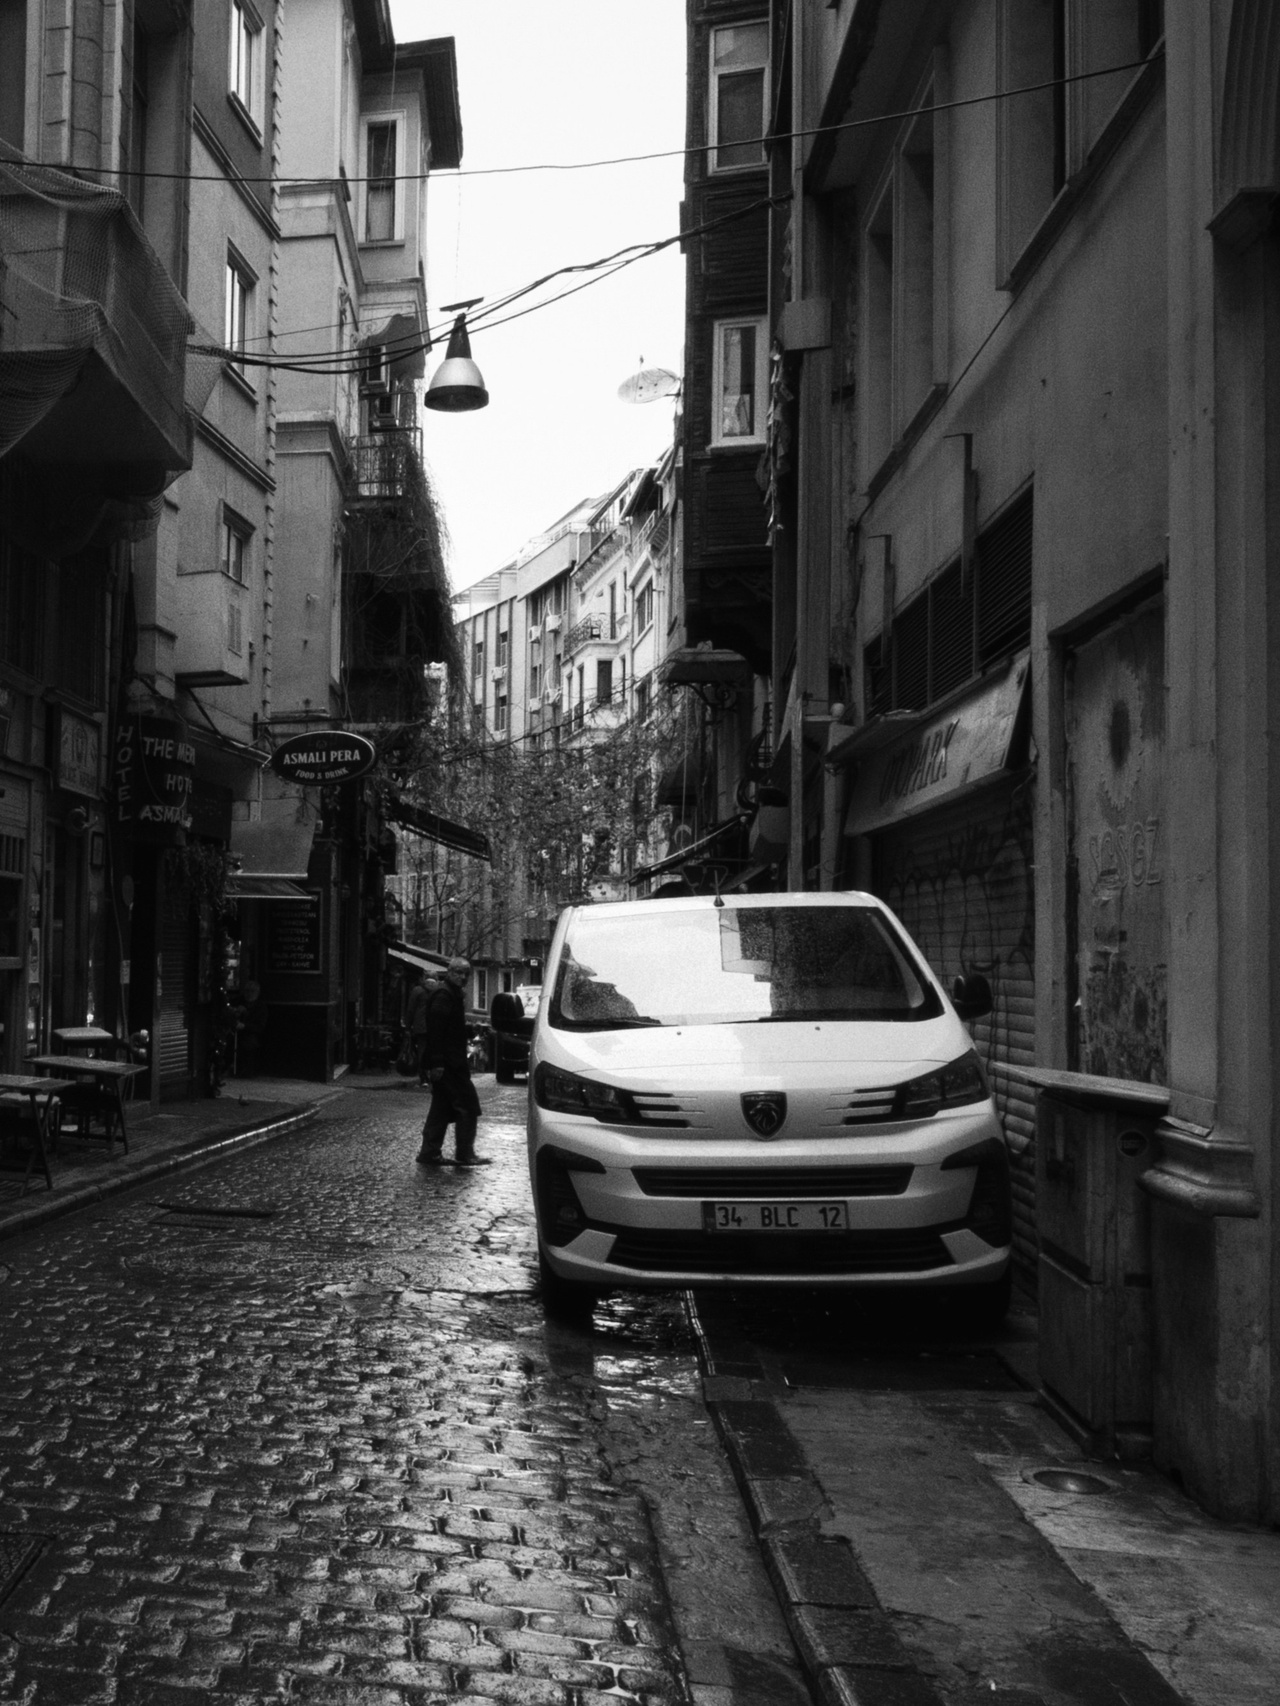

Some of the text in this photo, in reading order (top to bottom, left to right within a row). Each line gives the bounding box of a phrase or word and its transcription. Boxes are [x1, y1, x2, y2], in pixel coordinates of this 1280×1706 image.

[142, 736, 175, 760] THE
[283, 748, 361, 765] ASMALI PERA
[116, 725, 133, 822] HOTEL
[166, 773, 193, 795] HOTE
[295, 768, 315, 780] FOOD
[325, 766, 349, 779] DRINK
[139, 803, 188, 826] ASMAL
[717, 1206, 842, 1228] 34 BLC 12
